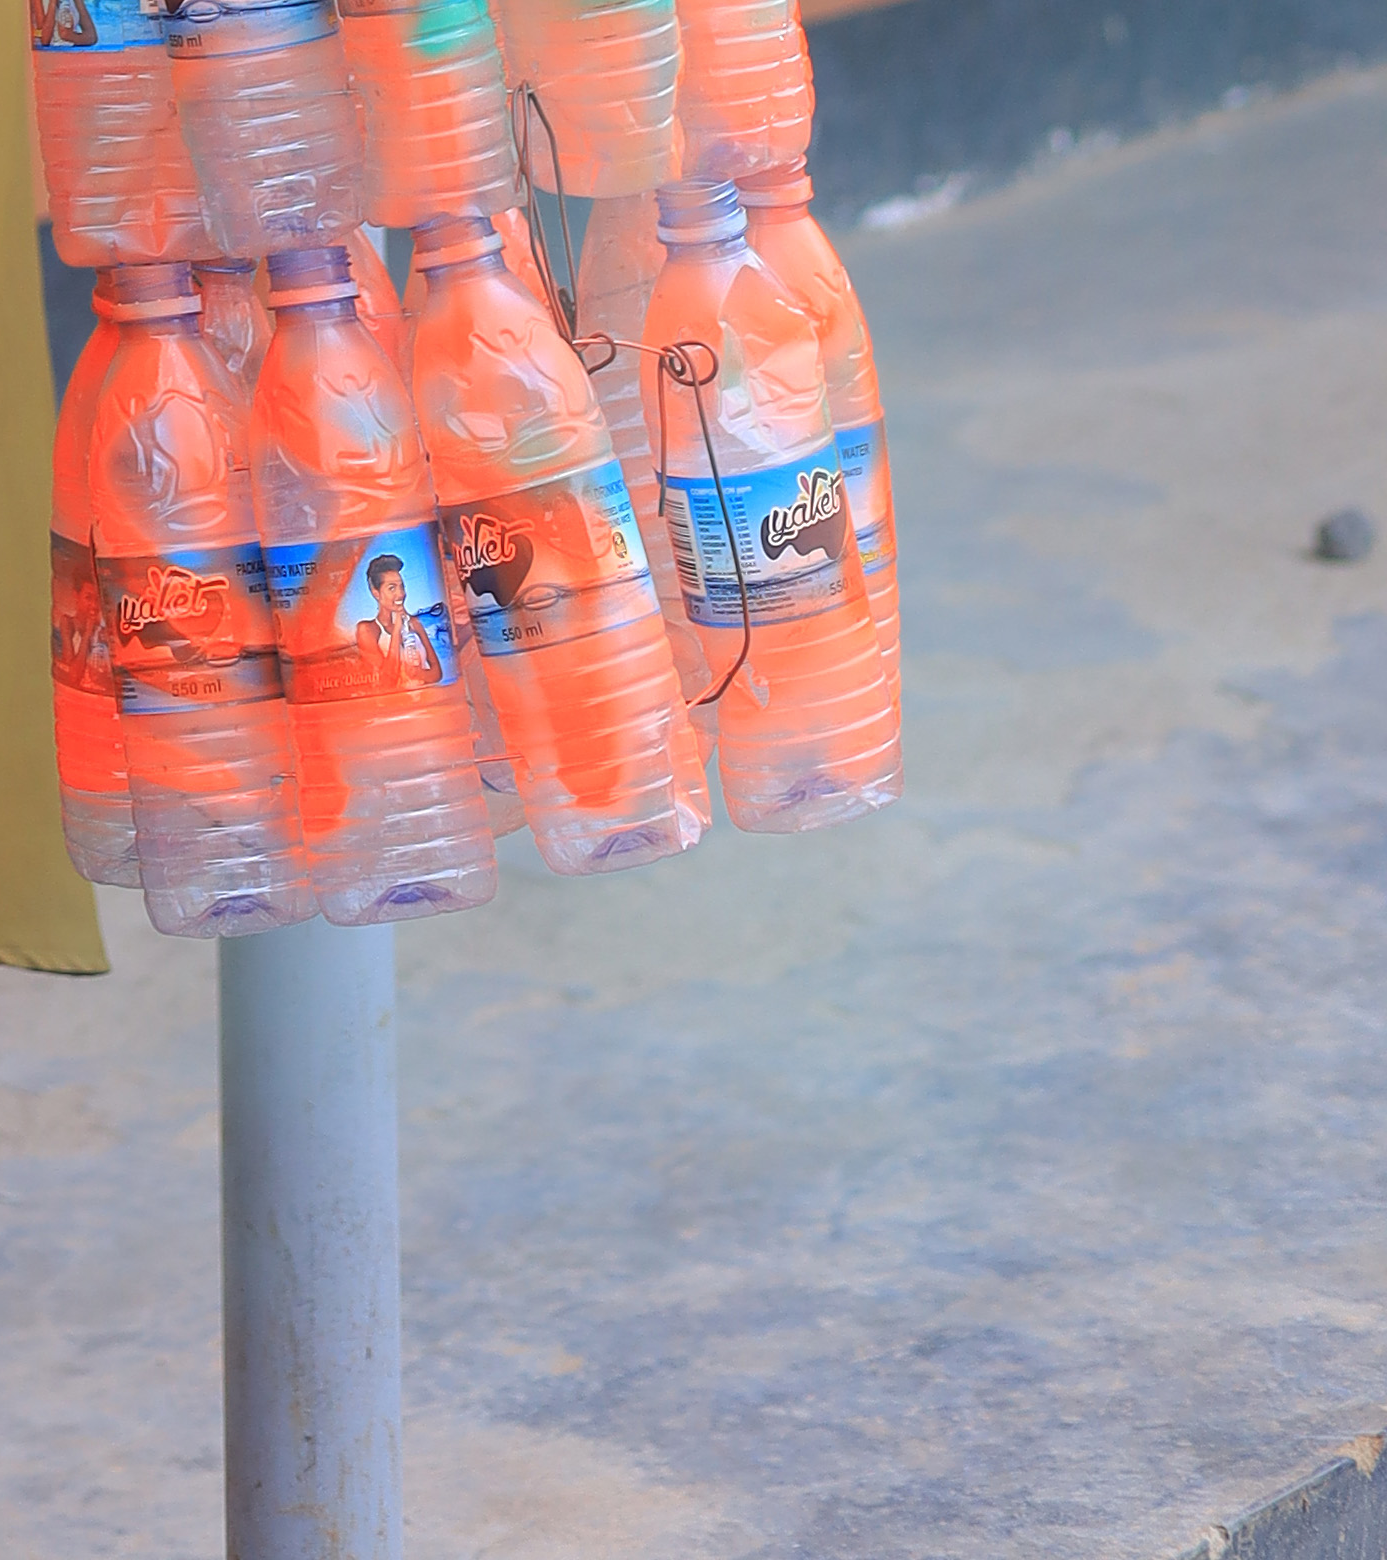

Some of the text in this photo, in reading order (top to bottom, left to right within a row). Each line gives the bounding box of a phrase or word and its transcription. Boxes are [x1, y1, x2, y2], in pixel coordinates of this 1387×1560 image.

[186, 33, 202, 48] ml
[842, 443, 870, 460] WATER
[288, 562, 318, 577] WATER
[502, 622, 544, 642] 550 ml
[172, 679, 221, 697] 550 ml
